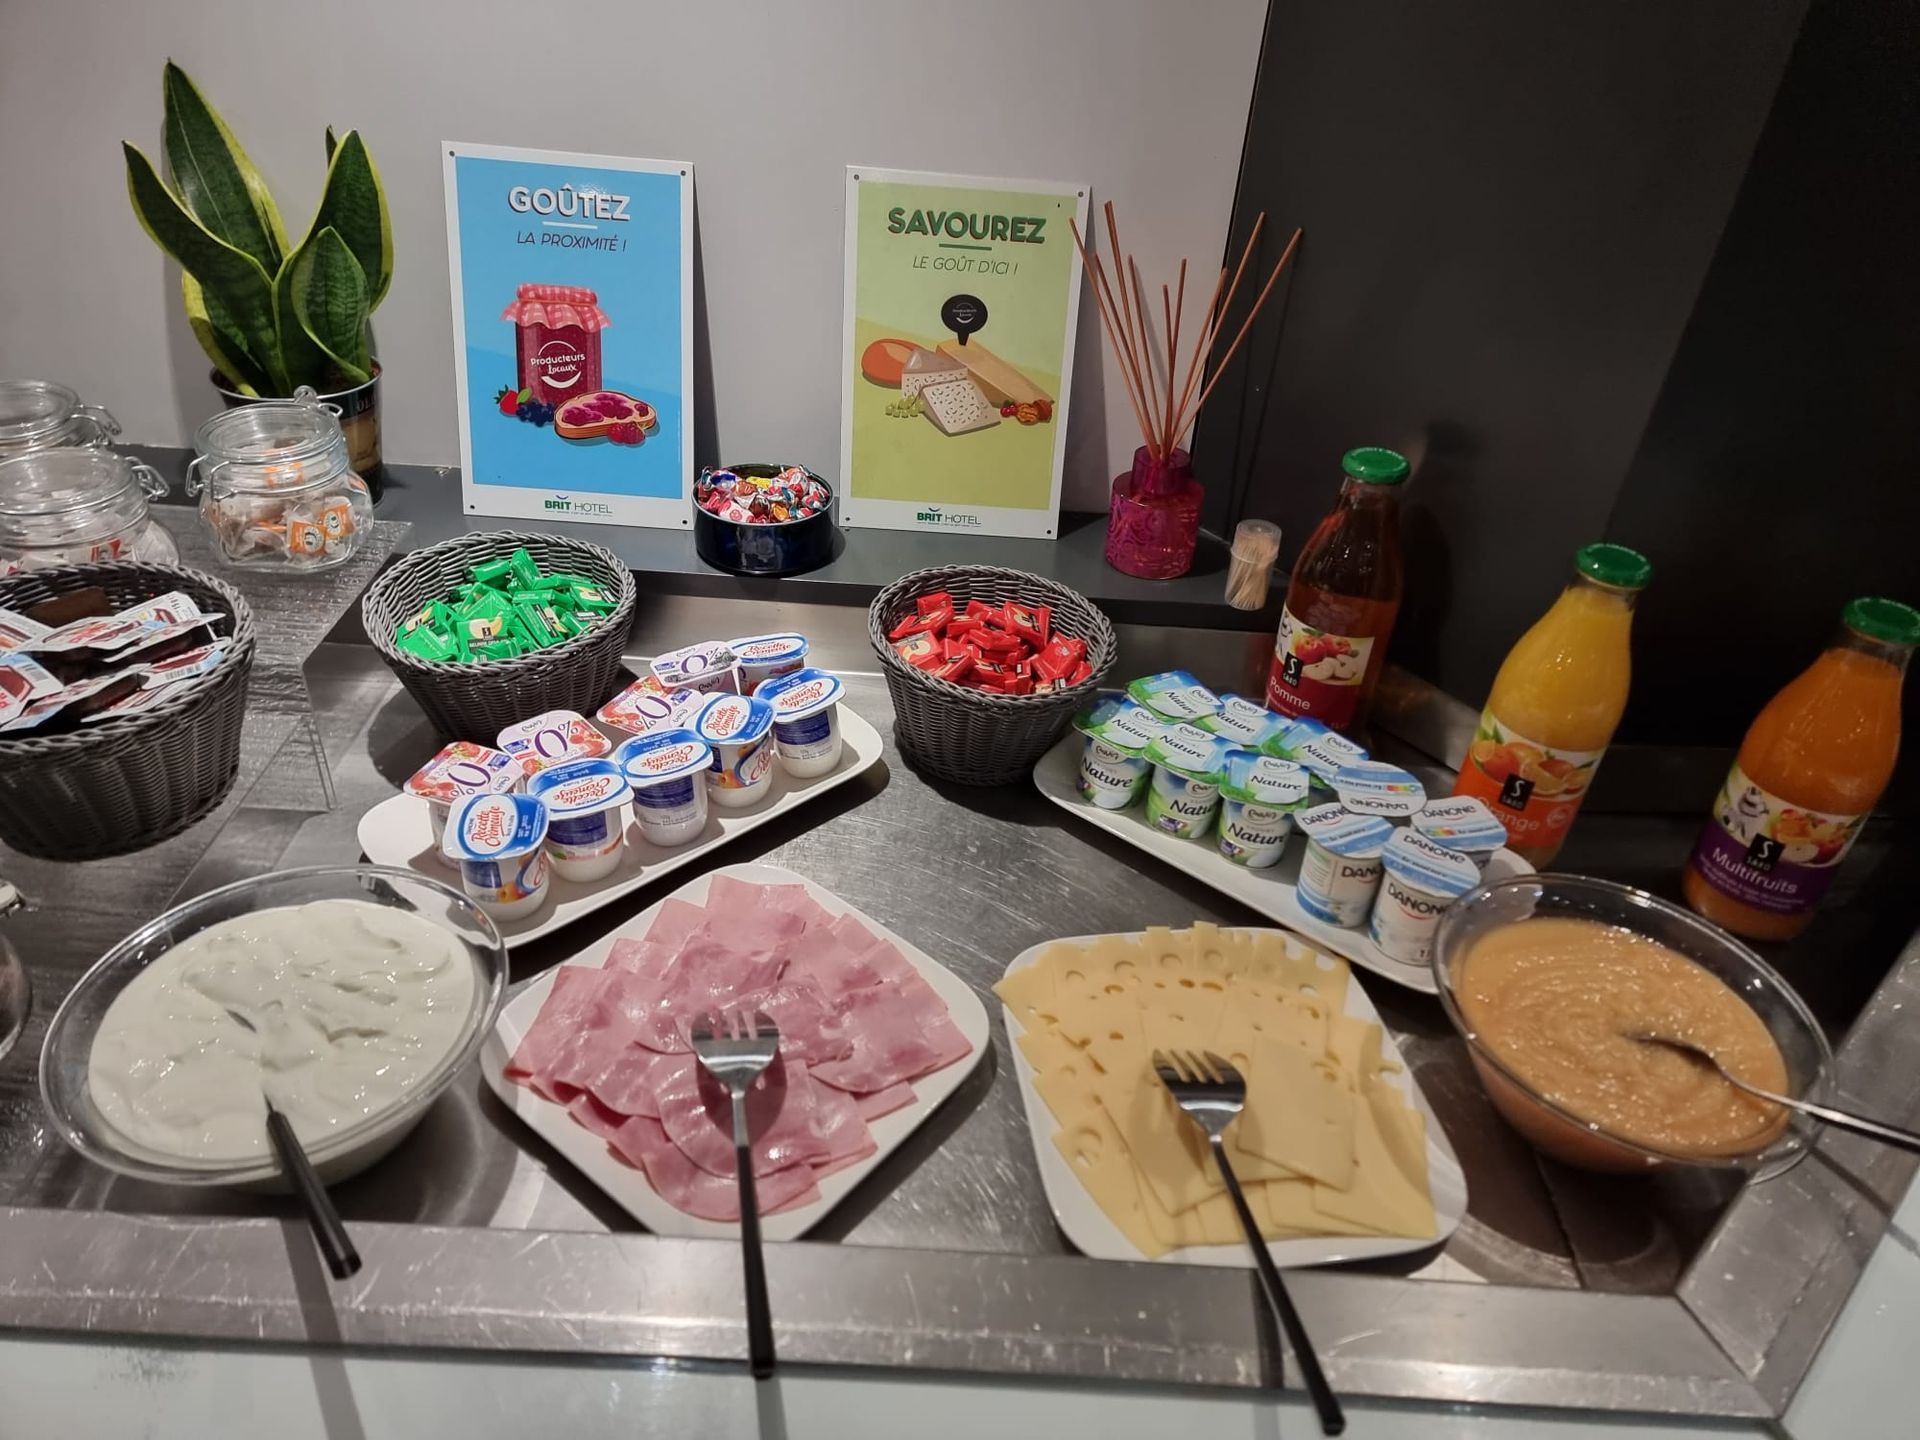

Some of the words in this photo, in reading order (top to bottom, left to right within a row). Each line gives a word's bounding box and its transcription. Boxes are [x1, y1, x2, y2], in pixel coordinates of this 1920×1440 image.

[508, 183, 631, 221] GOÛTEZ
[887, 207, 1047, 244] SAVOUREZ
[517, 232, 536, 245] LA
[541, 233, 619, 252] PROXIMITÉ
[912, 256, 929, 269] LE
[933, 256, 974, 272] GOÛT
[978, 260, 1010, 275] D'ICI
[530, 353, 586, 366] Producteurs
[548, 364, 577, 375] Locaux
[545, 500, 571, 510] BRIT
[574, 502, 613, 514] HOTEL
[917, 512, 943, 522] BRIT
[945, 514, 982, 525] HOTEL
[1270, 676, 1310, 710] Pomme
[706, 707, 728, 731] Recette
[1112, 719, 1152, 741] Natur
[1160, 735, 1206, 759] Nature
[1302, 744, 1342, 769] Natur
[1082, 756, 1133, 788] Nature
[1250, 775, 1302, 791] Nature
[1350, 798, 1408, 811] DANONE
[1421, 805, 1476, 818] DANONE
[472, 810, 490, 842] Recette
[1228, 822, 1284, 845] Natur
[1403, 835, 1465, 864] DANONE
[1712, 847, 1798, 894] Multifruits
